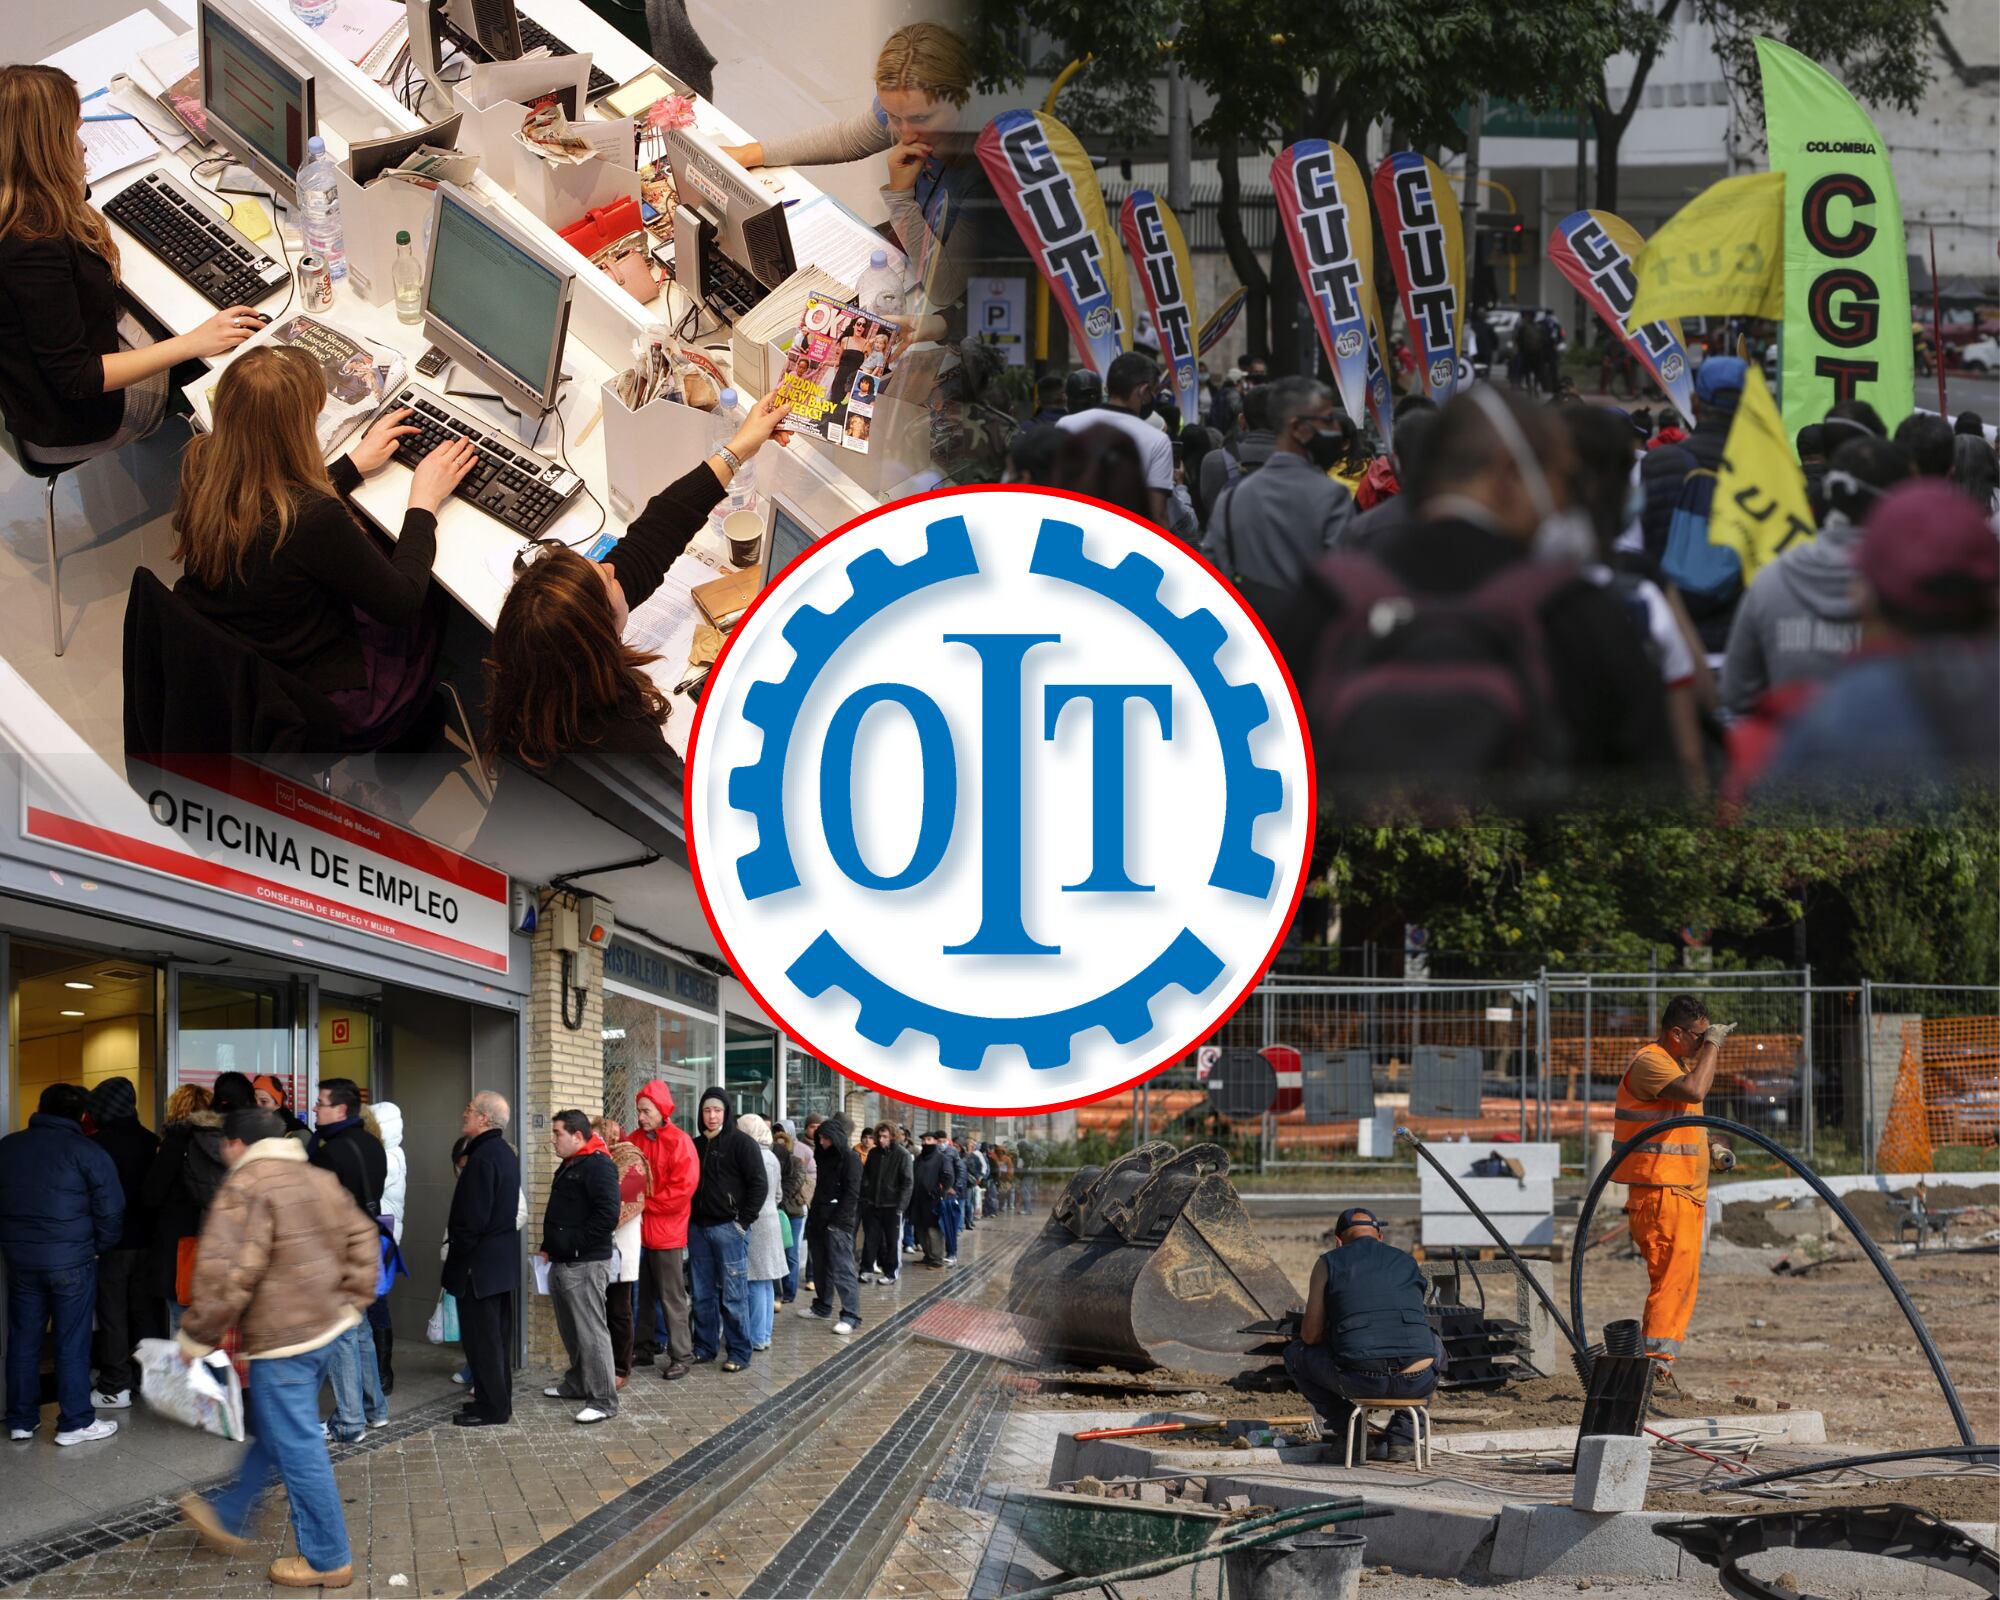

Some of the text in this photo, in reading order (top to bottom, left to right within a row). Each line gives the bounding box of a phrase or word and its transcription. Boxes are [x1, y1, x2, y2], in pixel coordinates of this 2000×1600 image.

[1806, 141, 1876, 155] COLOMBIA
[1001, 119, 1106, 303] CUT
[1294, 151, 1361, 324] CUT
[1395, 166, 1455, 351] CUT
[1134, 203, 1192, 360] CUT
[1802, 173, 1880, 404] CGT
[805, 303, 850, 339] OK!
[988, 306, 1005, 326] P
[300, 331, 348, 363] kissed Getty
[308, 325, 354, 356] Has Sienna
[784, 372, 827, 399] WEDDING
[787, 388, 809, 405] NEW
[808, 396, 838, 415] BABY
[298, 798, 381, 840] Comunidad de Madrid
[148, 789, 458, 924] OFICINA DE EMPLEO
[257, 886, 315, 912] CONSEJERÍA
[316, 904, 328, 915] DE
[330, 907, 362, 926] EMPLEO
[371, 920, 396, 936] MUJER
[603, 943, 670, 992] RISTALERIA
